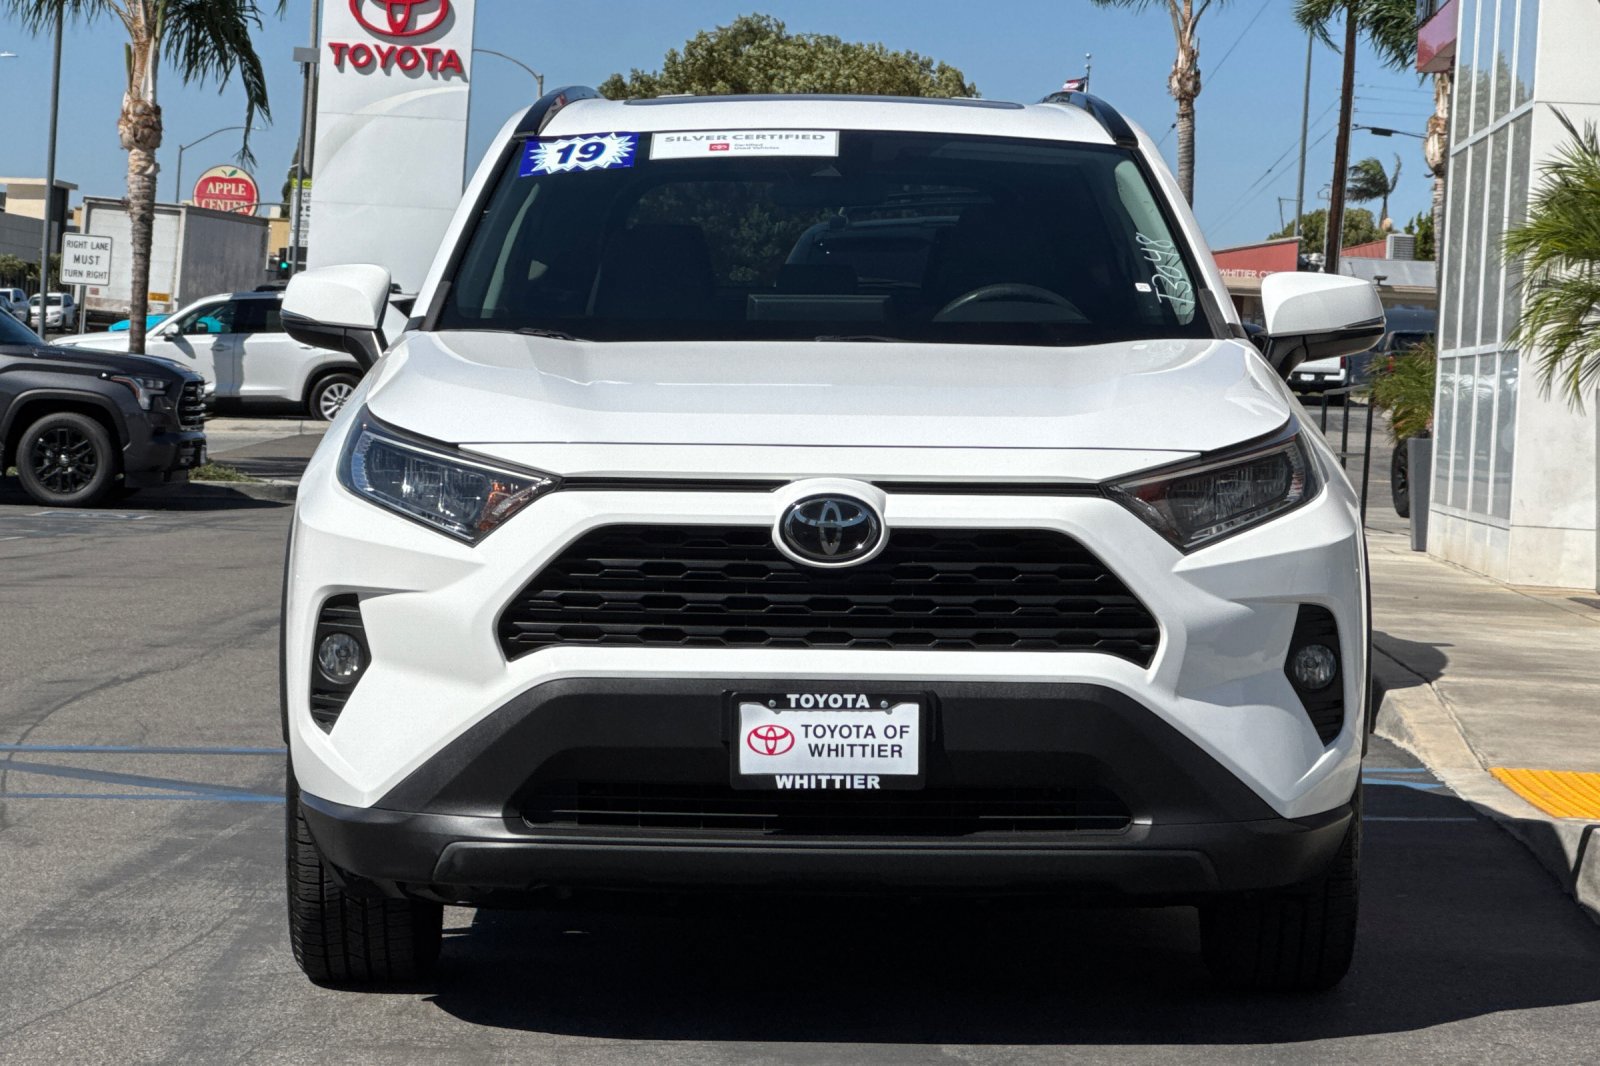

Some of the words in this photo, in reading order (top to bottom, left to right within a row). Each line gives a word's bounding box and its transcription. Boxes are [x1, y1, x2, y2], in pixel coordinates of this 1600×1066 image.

[328, 42, 463, 73] TOYOTA
[664, 135, 728, 143] SILVER
[732, 133, 826, 141] CERTIFIED
[556, 141, 606, 164] 19
[206, 181, 247, 196] APPLE
[201, 198, 249, 213] CENTER
[66, 240, 88, 249] RIGHT
[90, 241, 109, 251] LANE
[73, 254, 100, 265] MUST
[64, 269, 83, 278] TURN
[86, 270, 108, 280] RIGHT
[1218, 268, 1257, 278] WHITTIER
[787, 693, 870, 709] TOYOTA
[801, 724, 876, 739] TOYOTA
[883, 724, 910, 739] OF
[808, 744, 903, 758] WHITTIER
[775, 775, 881, 789] WHITTIER
